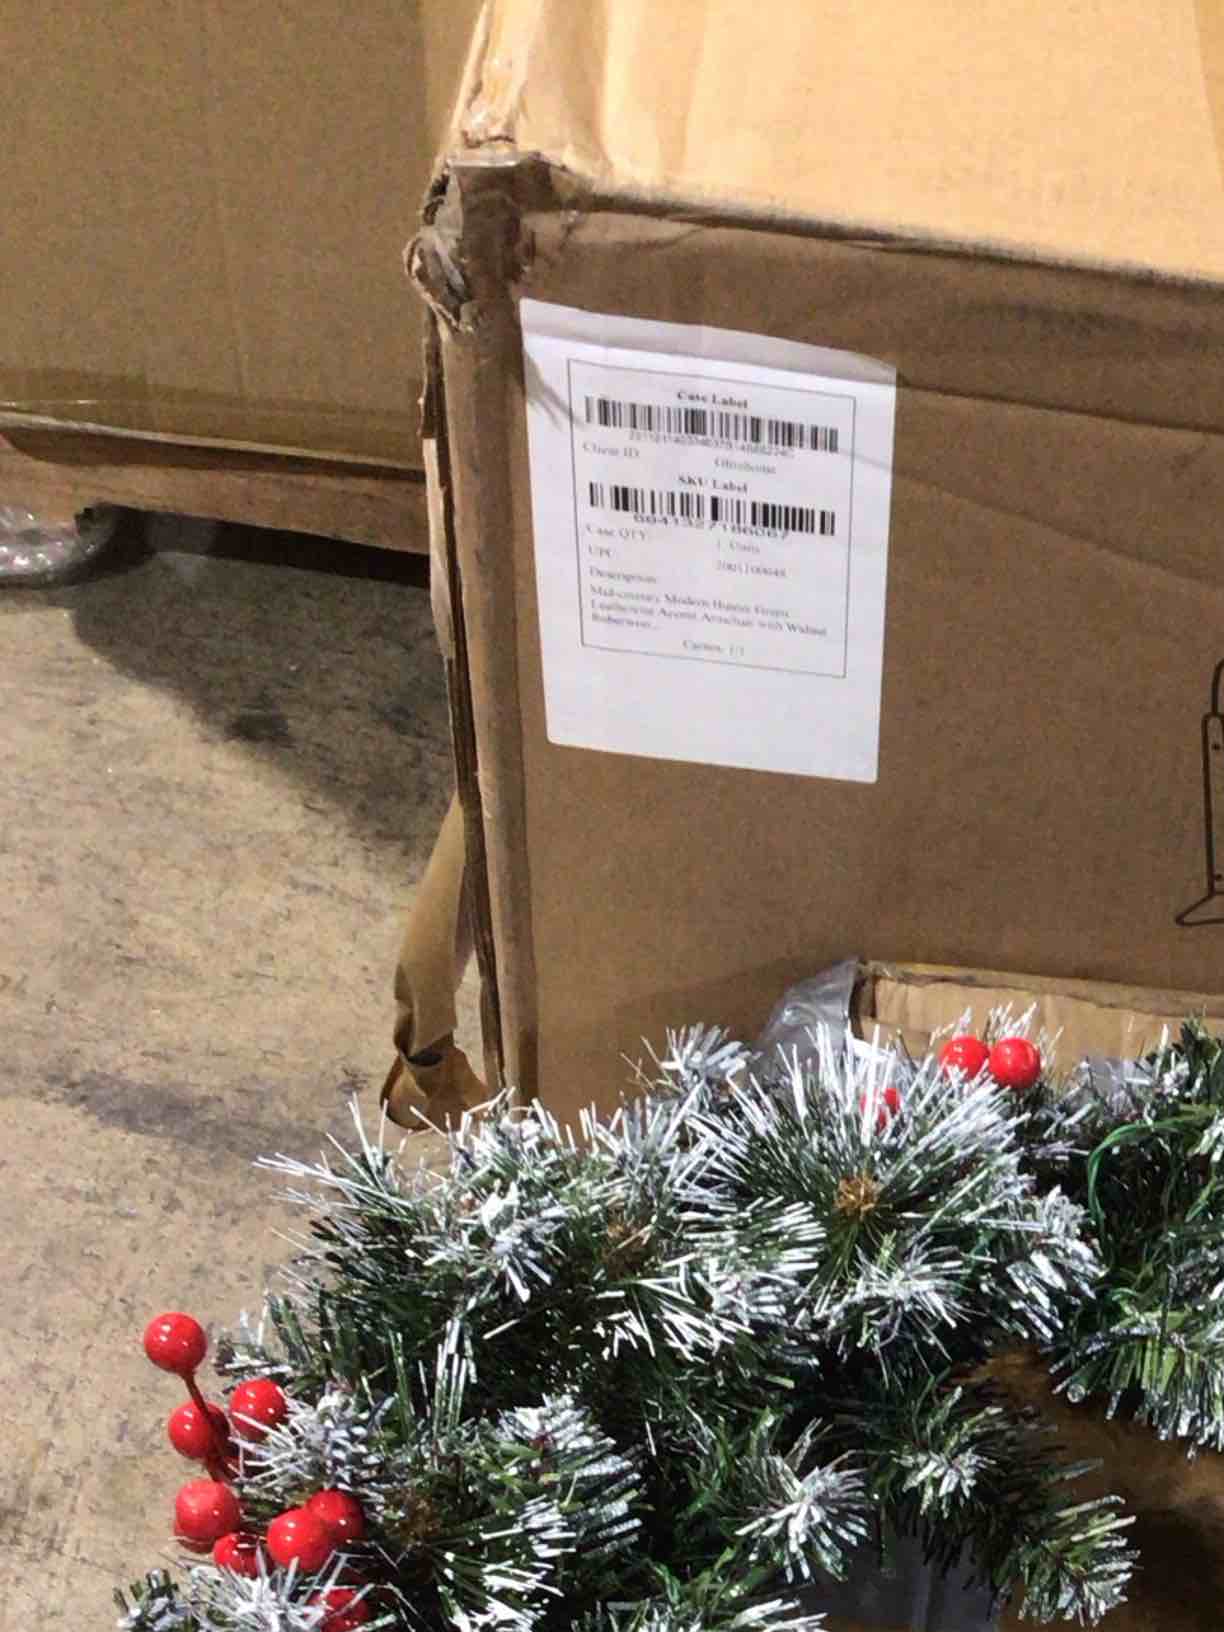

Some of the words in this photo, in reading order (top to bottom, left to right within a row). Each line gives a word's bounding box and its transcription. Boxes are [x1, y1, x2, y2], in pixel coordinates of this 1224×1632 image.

[677, 391, 707, 405] Case
[712, 393, 748, 409] Label
[679, 474, 706, 487] SKU
[713, 478, 748, 494] Label
[664, 591, 711, 609] Modern
